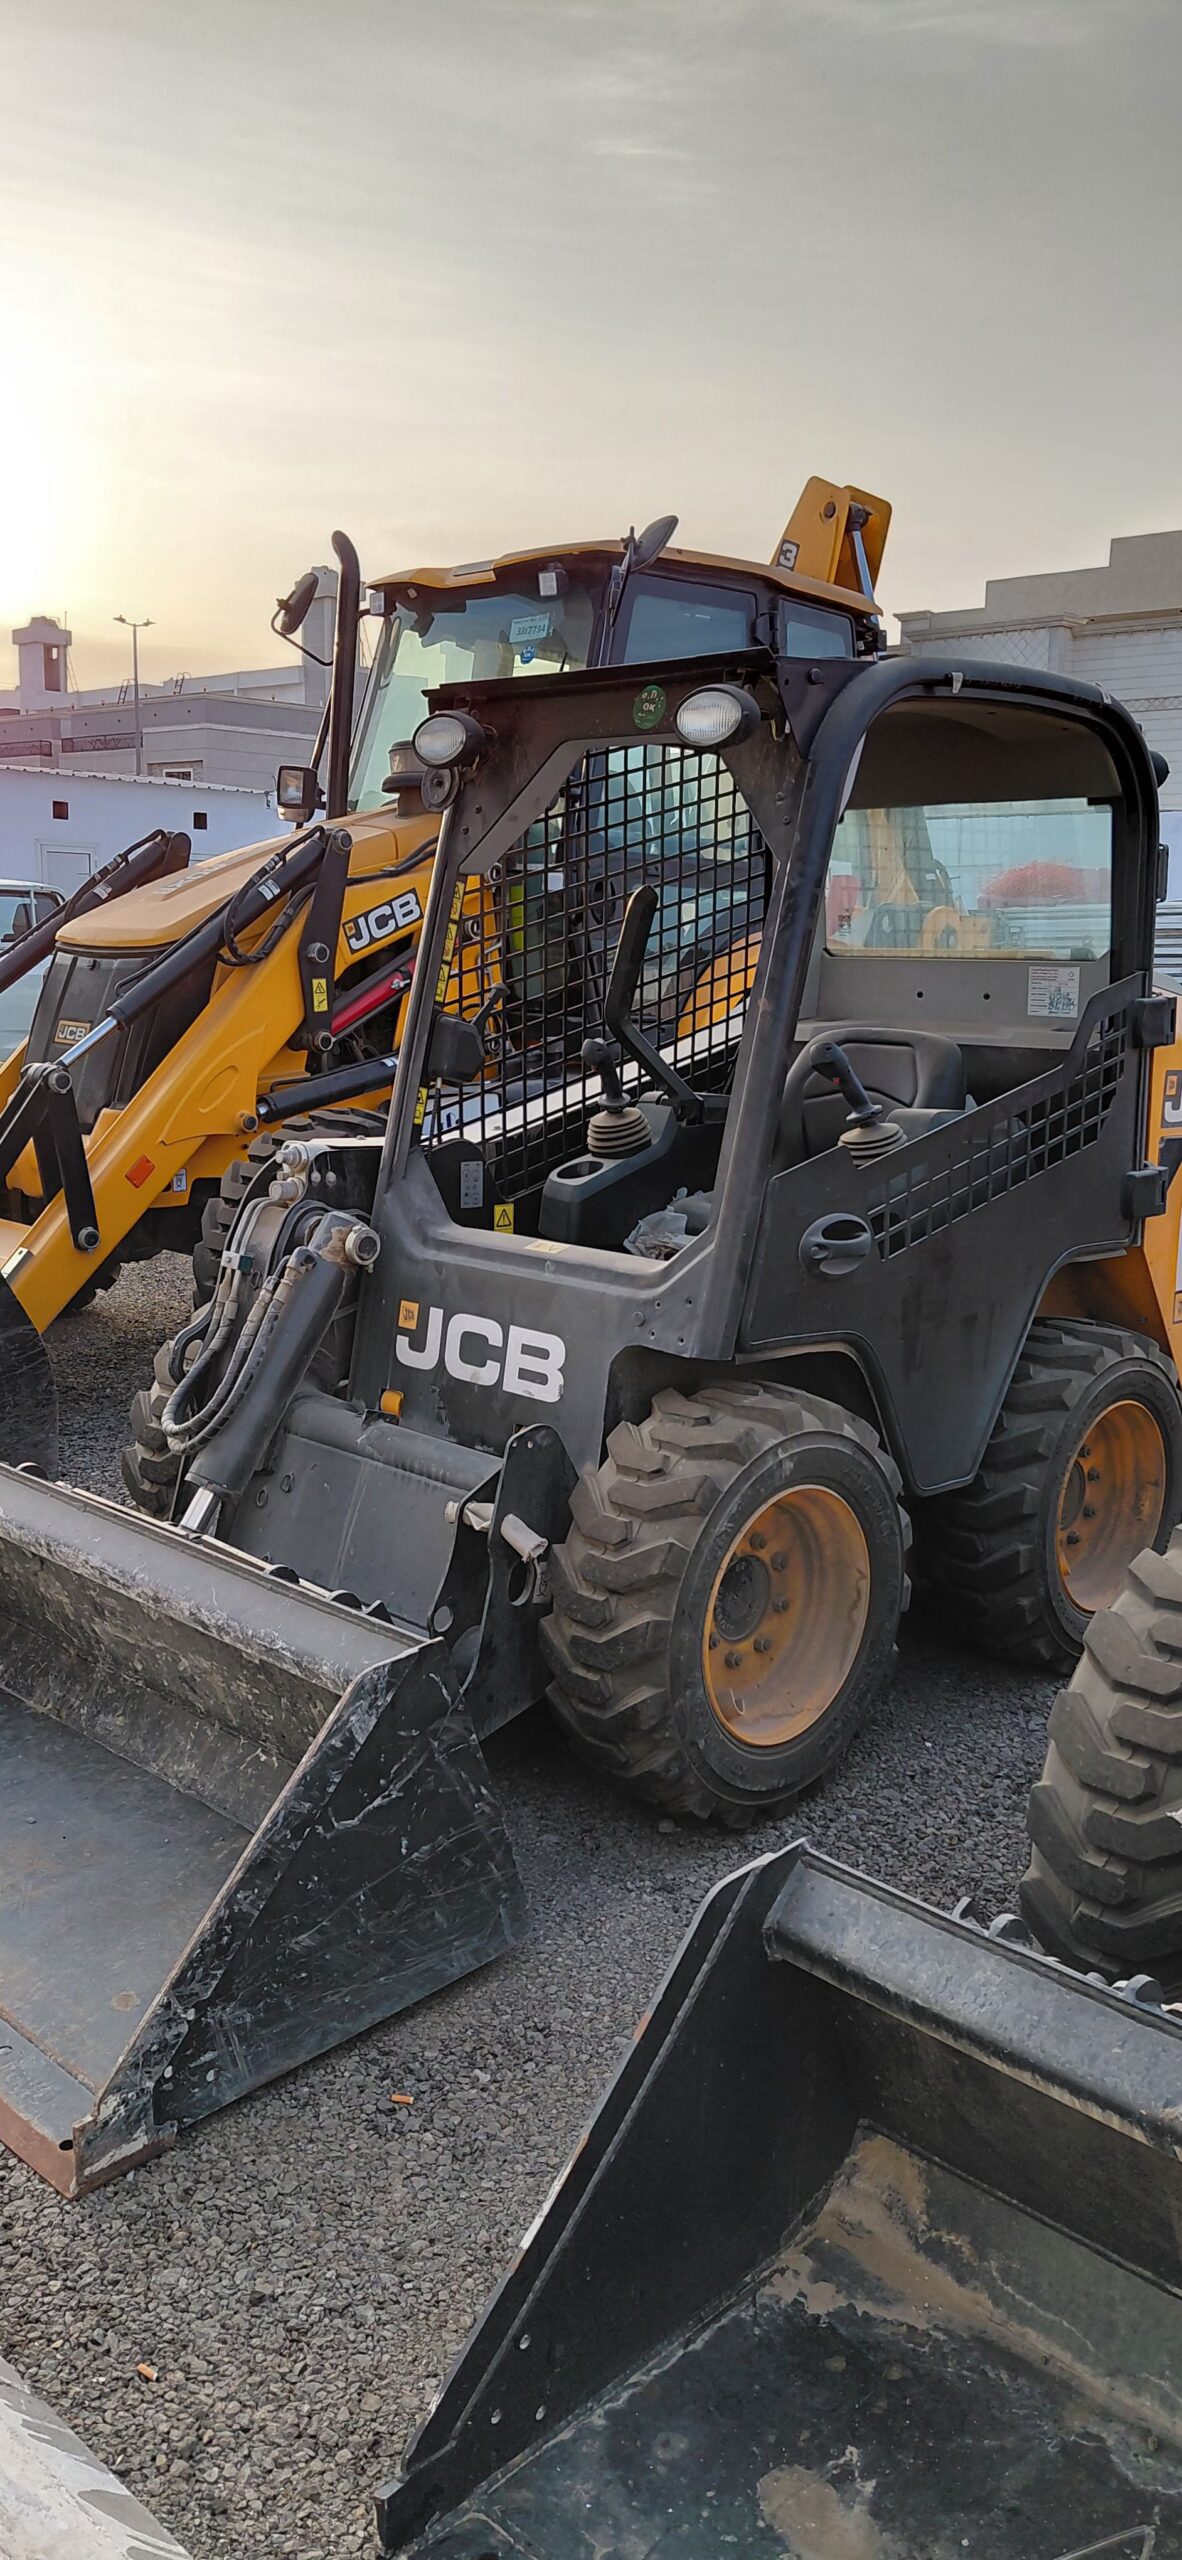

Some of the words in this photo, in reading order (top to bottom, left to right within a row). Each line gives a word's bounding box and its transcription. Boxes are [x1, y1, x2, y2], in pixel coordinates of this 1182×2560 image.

[779, 543, 798, 568] 3
[642, 702, 656, 713] OK
[349, 892, 421, 950] JCB
[58, 1025, 86, 1041] JCB
[395, 1306, 567, 1403] JCB
